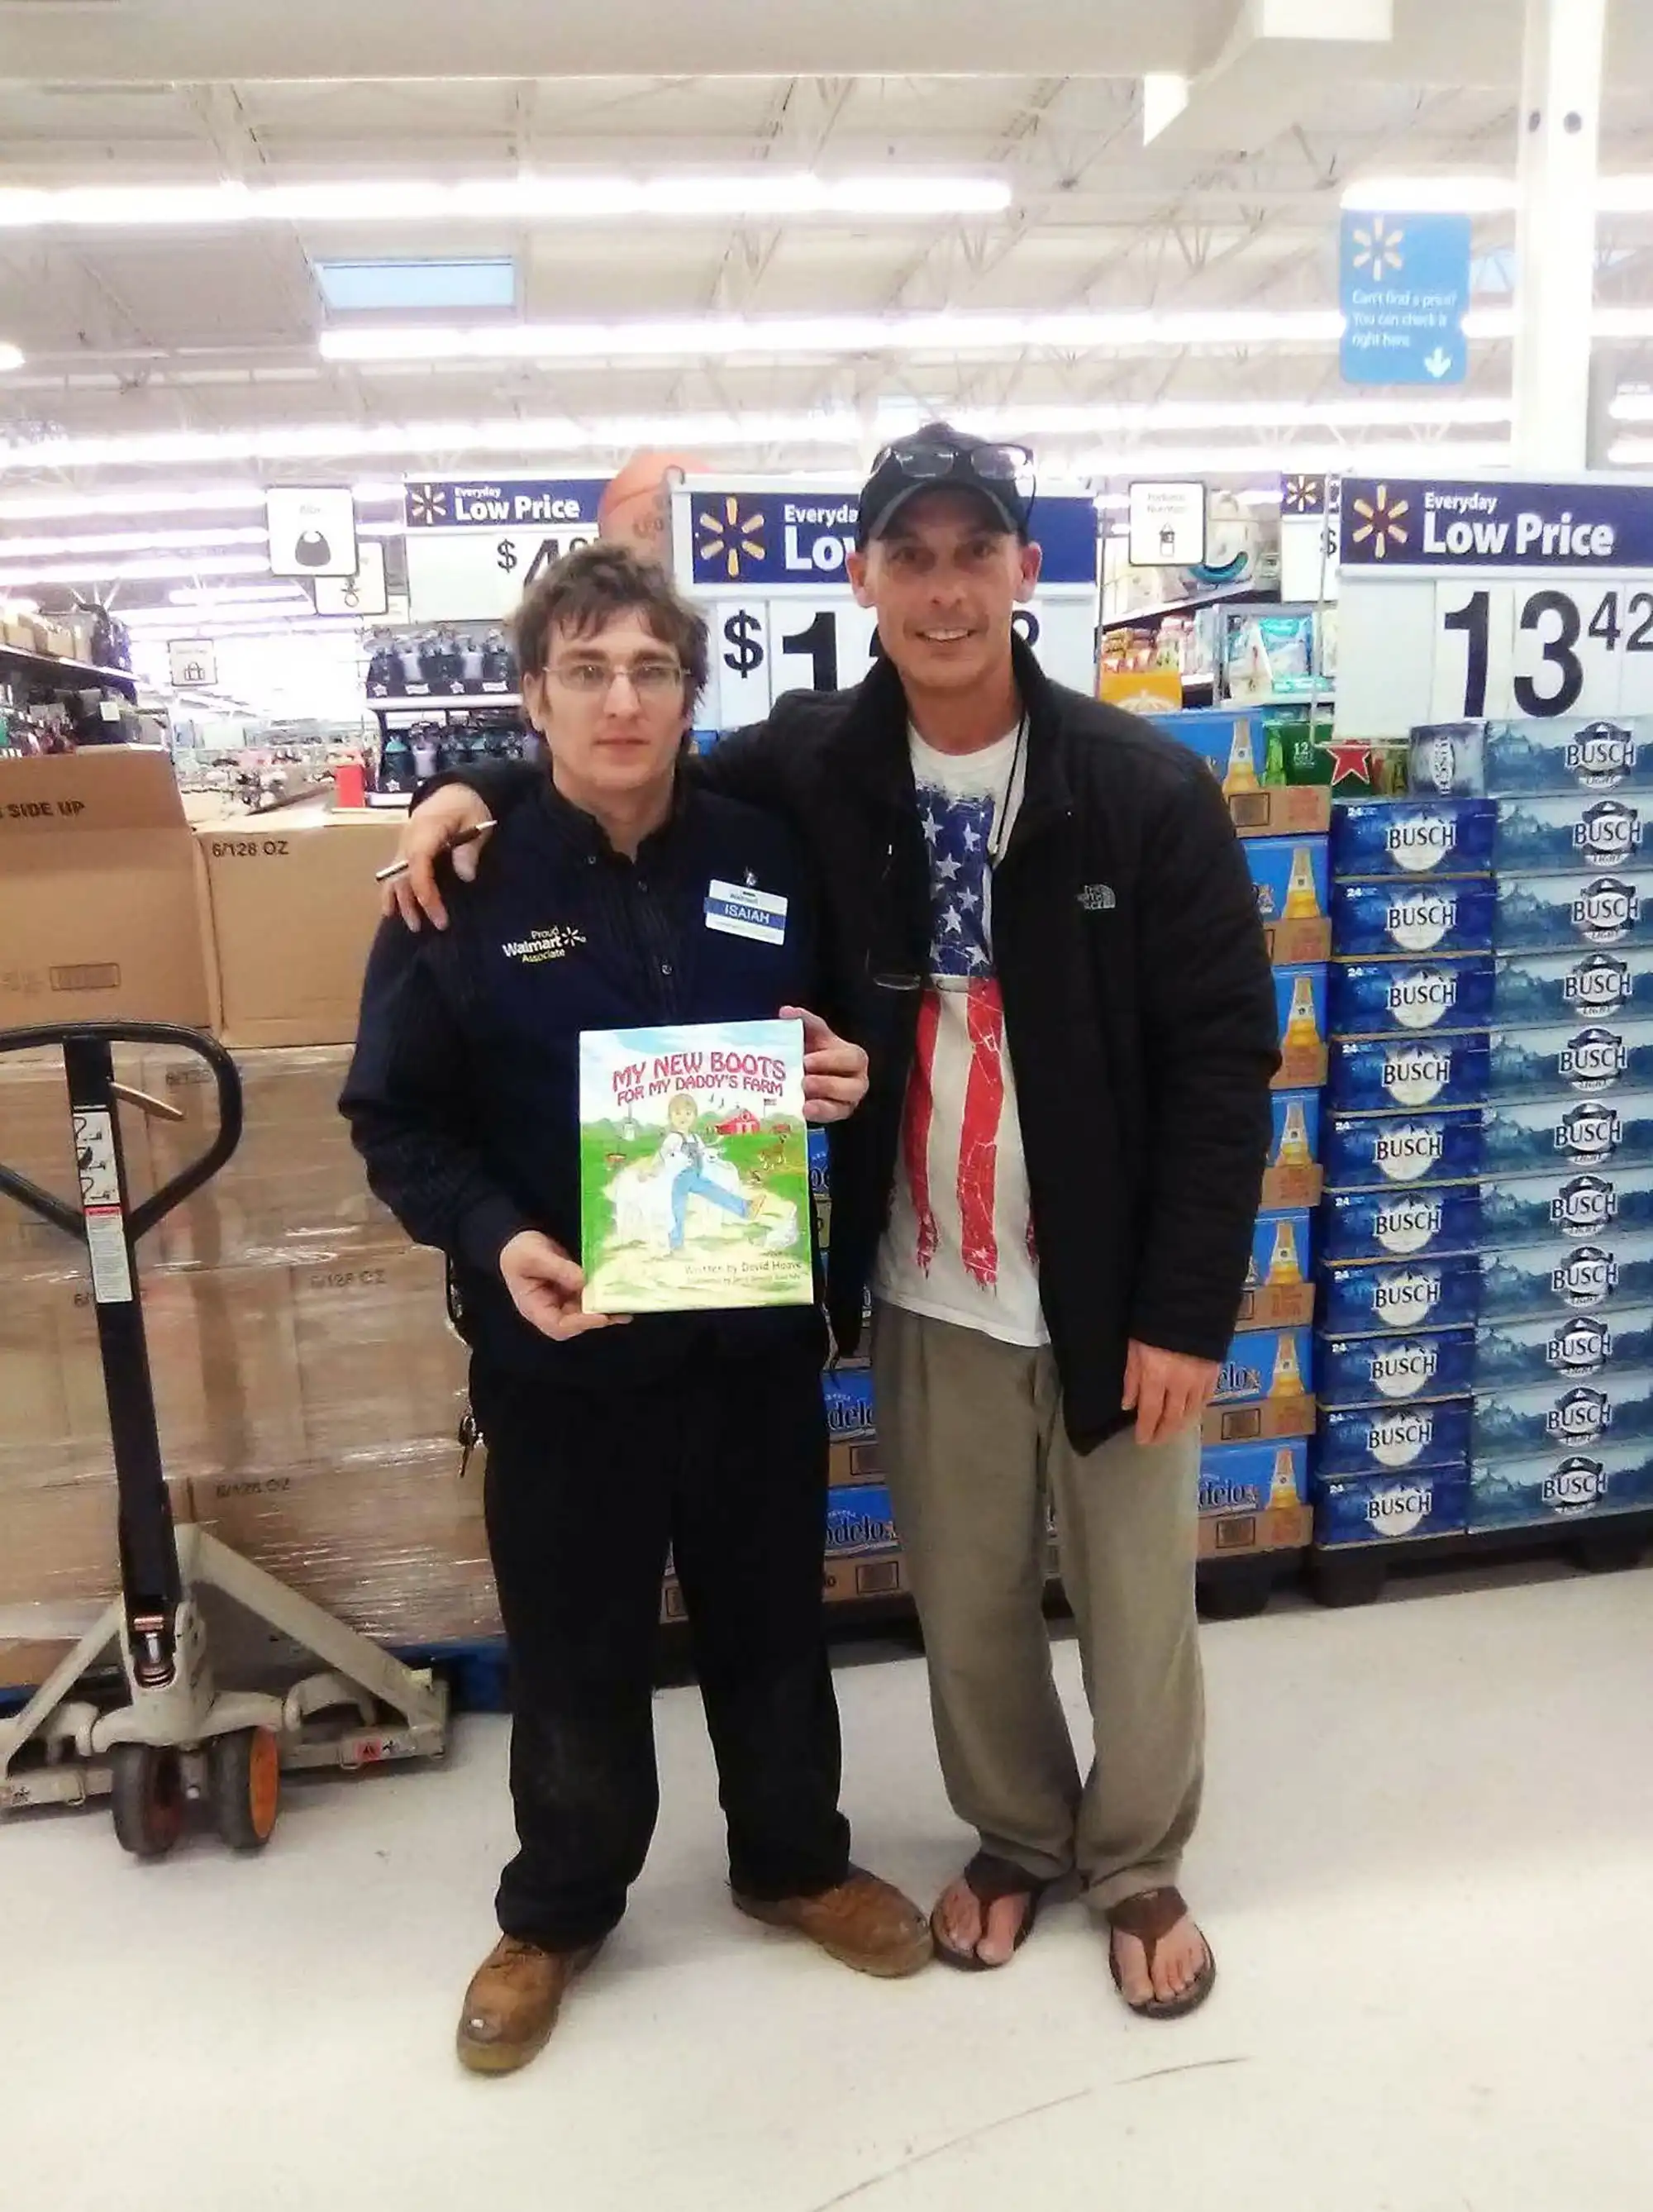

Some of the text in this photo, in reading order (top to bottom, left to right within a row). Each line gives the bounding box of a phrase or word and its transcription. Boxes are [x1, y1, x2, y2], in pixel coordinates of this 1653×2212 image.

[455, 487, 501, 498] Everyday
[1424, 492, 1498, 513] Everyday
[455, 494, 580, 521] Low Price
[784, 504, 860, 527] Everyda
[1423, 512, 1614, 556] Low Price
[497, 539, 517, 573] $
[723, 610, 764, 678] $
[1565, 745, 1636, 768] BUSCH
[7, 800, 85, 818] SIDE UP
[1389, 826, 1455, 850] BUSCH
[1574, 822, 1642, 846] BUSCH
[264, 840, 289, 856] OZ
[1346, 888, 1363, 898] 24
[724, 903, 770, 925] ISAIAH
[1389, 907, 1456, 931] BUSCH
[1573, 899, 1638, 922] BUSCH
[531, 926, 560, 939] Proud
[502, 935, 563, 957] Walmart
[522, 949, 565, 963] Associate
[1348, 967, 1363, 977] 24
[1389, 982, 1456, 1008] BUSCH
[1565, 974, 1632, 998] BUSCH
[1342, 1044, 1357, 1054] 24
[1560, 1047, 1627, 1071] BUSCH
[612, 1051, 786, 1092] MY NEW BOOTS
[1383, 1060, 1450, 1085] BUSCH
[617, 1075, 784, 1107] FOR MY DADDY'S FARM
[1336, 1122, 1350, 1131] 24
[1555, 1122, 1622, 1147] BUSCH
[1375, 1136, 1442, 1162] BUSCH
[1335, 1197, 1350, 1207] 24
[1551, 1195, 1617, 1219] BUSCH
[1374, 1208, 1441, 1236] BUSCH
[1334, 1270, 1350, 1280] 24
[1553, 1264, 1618, 1290] BUSCH
[1374, 1283, 1440, 1309] BUSCH
[1547, 1337, 1611, 1361] BUSCH
[1371, 1355, 1436, 1380] BUSCH
[1547, 1407, 1611, 1431] BUSCH
[1368, 1423, 1432, 1450] BUSCH
[1543, 1475, 1607, 1499] BUSCH
[1367, 1493, 1431, 1519] BUSCH
